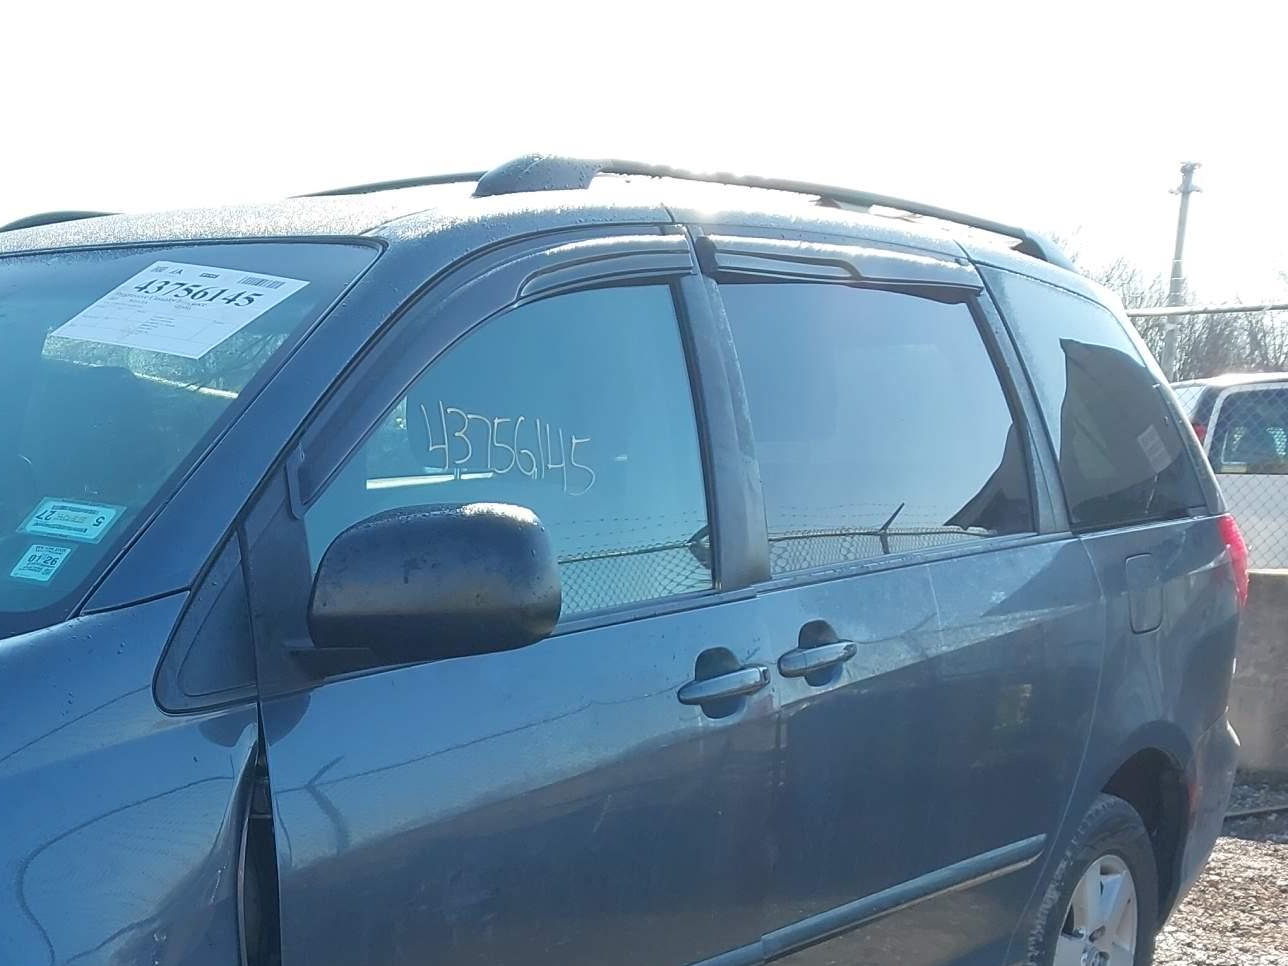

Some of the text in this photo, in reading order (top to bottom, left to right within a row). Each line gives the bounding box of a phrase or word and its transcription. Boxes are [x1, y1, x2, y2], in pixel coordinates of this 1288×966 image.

[134, 279, 265, 308] 43756145
[420, 400, 596, 496] 43756145
[43, 555, 59, 565] 26
